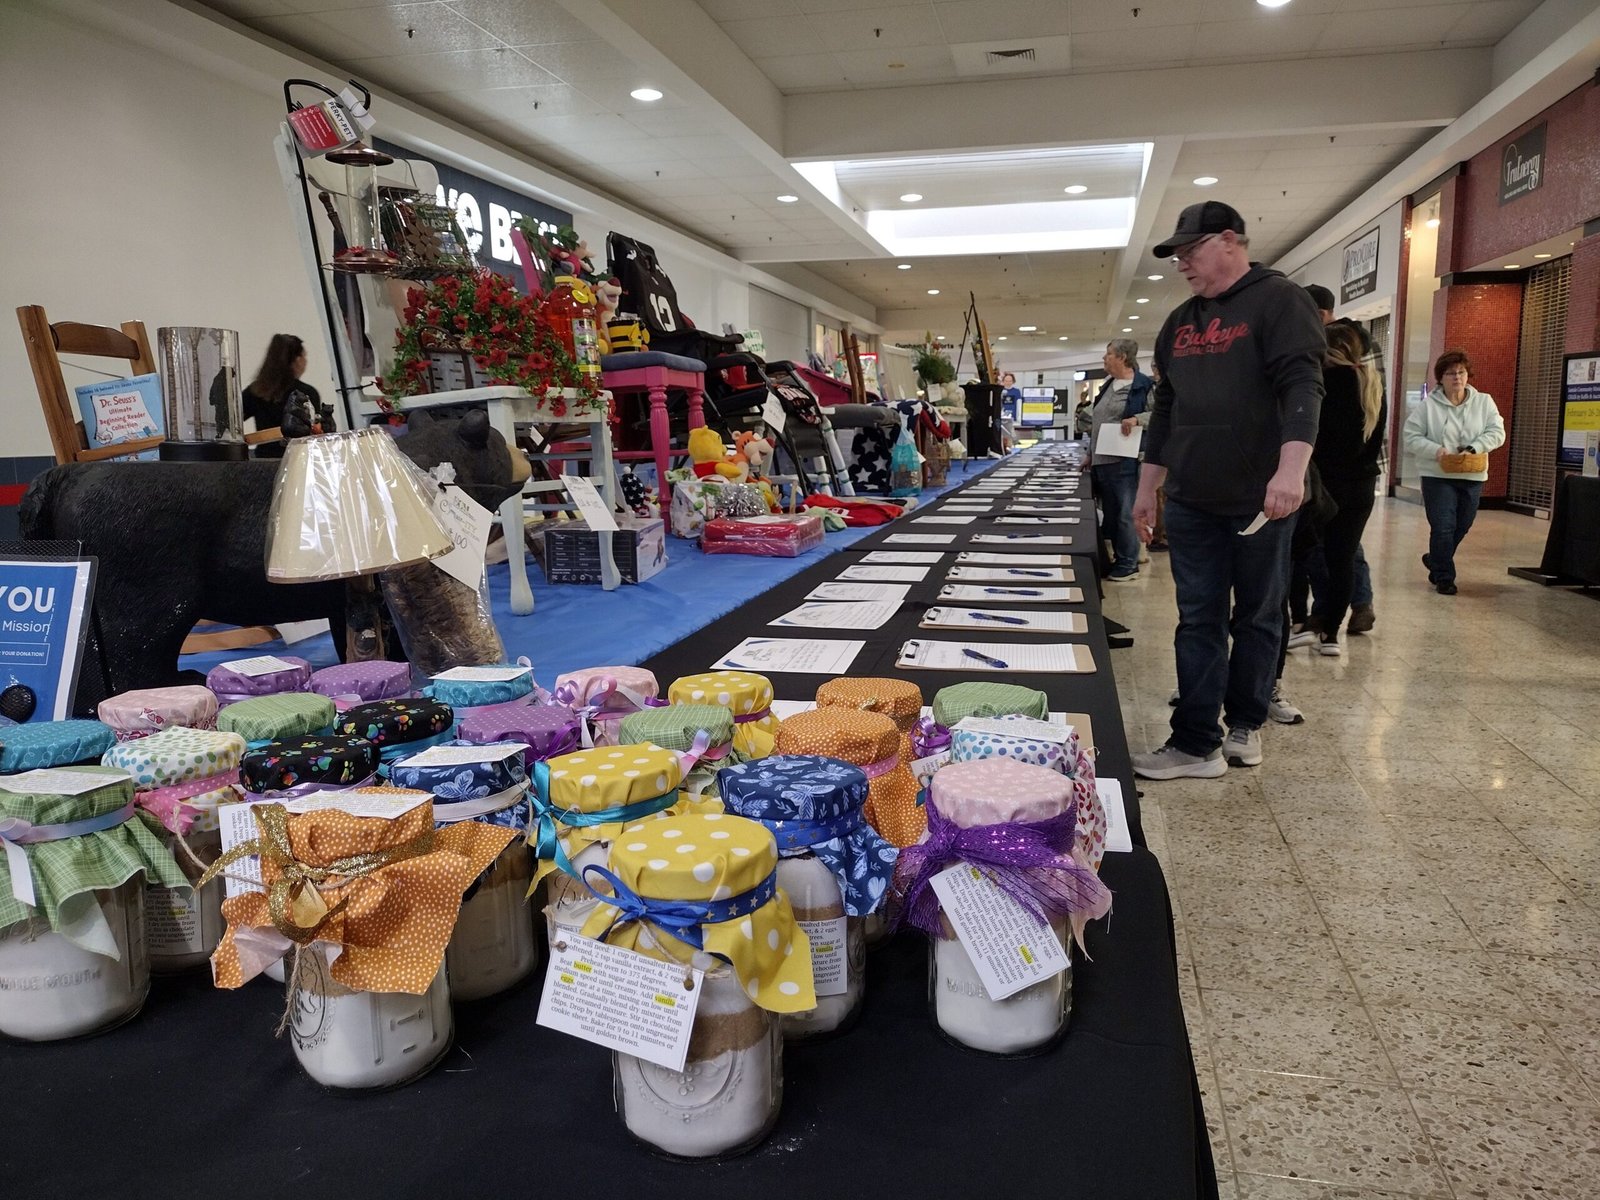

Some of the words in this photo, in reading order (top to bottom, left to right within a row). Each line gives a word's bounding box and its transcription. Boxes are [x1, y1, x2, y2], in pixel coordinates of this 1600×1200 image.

[99, 397, 112, 408] Dr.
[112, 392, 136, 406] Seuss's
[108, 405, 132, 414] Ultimate
[99, 415, 126, 427] Beginning
[126, 411, 146, 420] Reader
[2, 620, 49, 634] Mission
[568, 935, 581, 944] You
[581, 939, 593, 948] will
[593, 943, 610, 953] need:
[616, 950, 629, 960] cup
[637, 956, 666, 970] unsalted
[666, 965, 686, 976] butte
[580, 955, 603, 967] Preheat
[603, 963, 619, 972] oven
[619, 967, 628, 975] to
[628, 970, 640, 979] 375
[640, 974, 668, 988] degrees.
[599, 953, 610, 962] tsp
[611, 956, 632, 967] vanilla
[632, 963, 657, 975] extract,
[553, 963, 579, 976] medium
[579, 972, 598, 983] speed
[597, 977, 613, 987] until
[613, 983, 638, 996] creamy.
[639, 990, 654, 1000] Add
[653, 994, 676, 1007] vanilla
[675, 1001, 689, 1011] and
[559, 957, 573, 966] Beat
[573, 961, 592, 972] butter
[592, 967, 607, 977] with
[606, 973, 625, 984] sugar
[626, 978, 639, 986] and
[638, 982, 660, 993] brown
[659, 989, 679, 1000] sugar
[551, 988, 561, 997] jar
[561, 991, 575, 1001] into
[574, 996, 602, 1009] creamed
[601, 1004, 629, 1018] mixture.
[628, 1012, 641, 1022] Stir
[641, 1016, 649, 1024] in
[648, 1019, 680, 1034] chocolate
[552, 979, 579, 993] blended.
[578, 988, 609, 1004] Gradually
[609, 998, 628, 1009] blend
[627, 1003, 640, 1014] dry
[640, 1007, 666, 1021] mixture
[665, 1016, 683, 1027] from
[575, 980, 588, 988] one
[600, 988, 618, 998] time,
[617, 992, 640, 1006] mixing
[649, 1002, 662, 1011] low
[662, 1006, 679, 1017] until
[549, 996, 569, 1008] chips.
[568, 1002, 585, 1013] Drop
[584, 1007, 594, 1016] by
[593, 1010, 629, 1027] tablespoon
[628, 1022, 645, 1031] onto
[644, 1027, 678, 1043] ungreased
[550, 1004, 570, 1016] cookie
[570, 1011, 590, 1022] sheet.
[589, 1017, 606, 1027] Bake
[605, 1022, 616, 1030] for
[616, 1025, 622, 1033] 9
[630, 1030, 639, 1038] 11
[639, 1033, 666, 1047] minutes
[579, 1023, 595, 1033] until
[595, 1028, 617, 1041] golden
[617, 1035, 641, 1047] brown.
